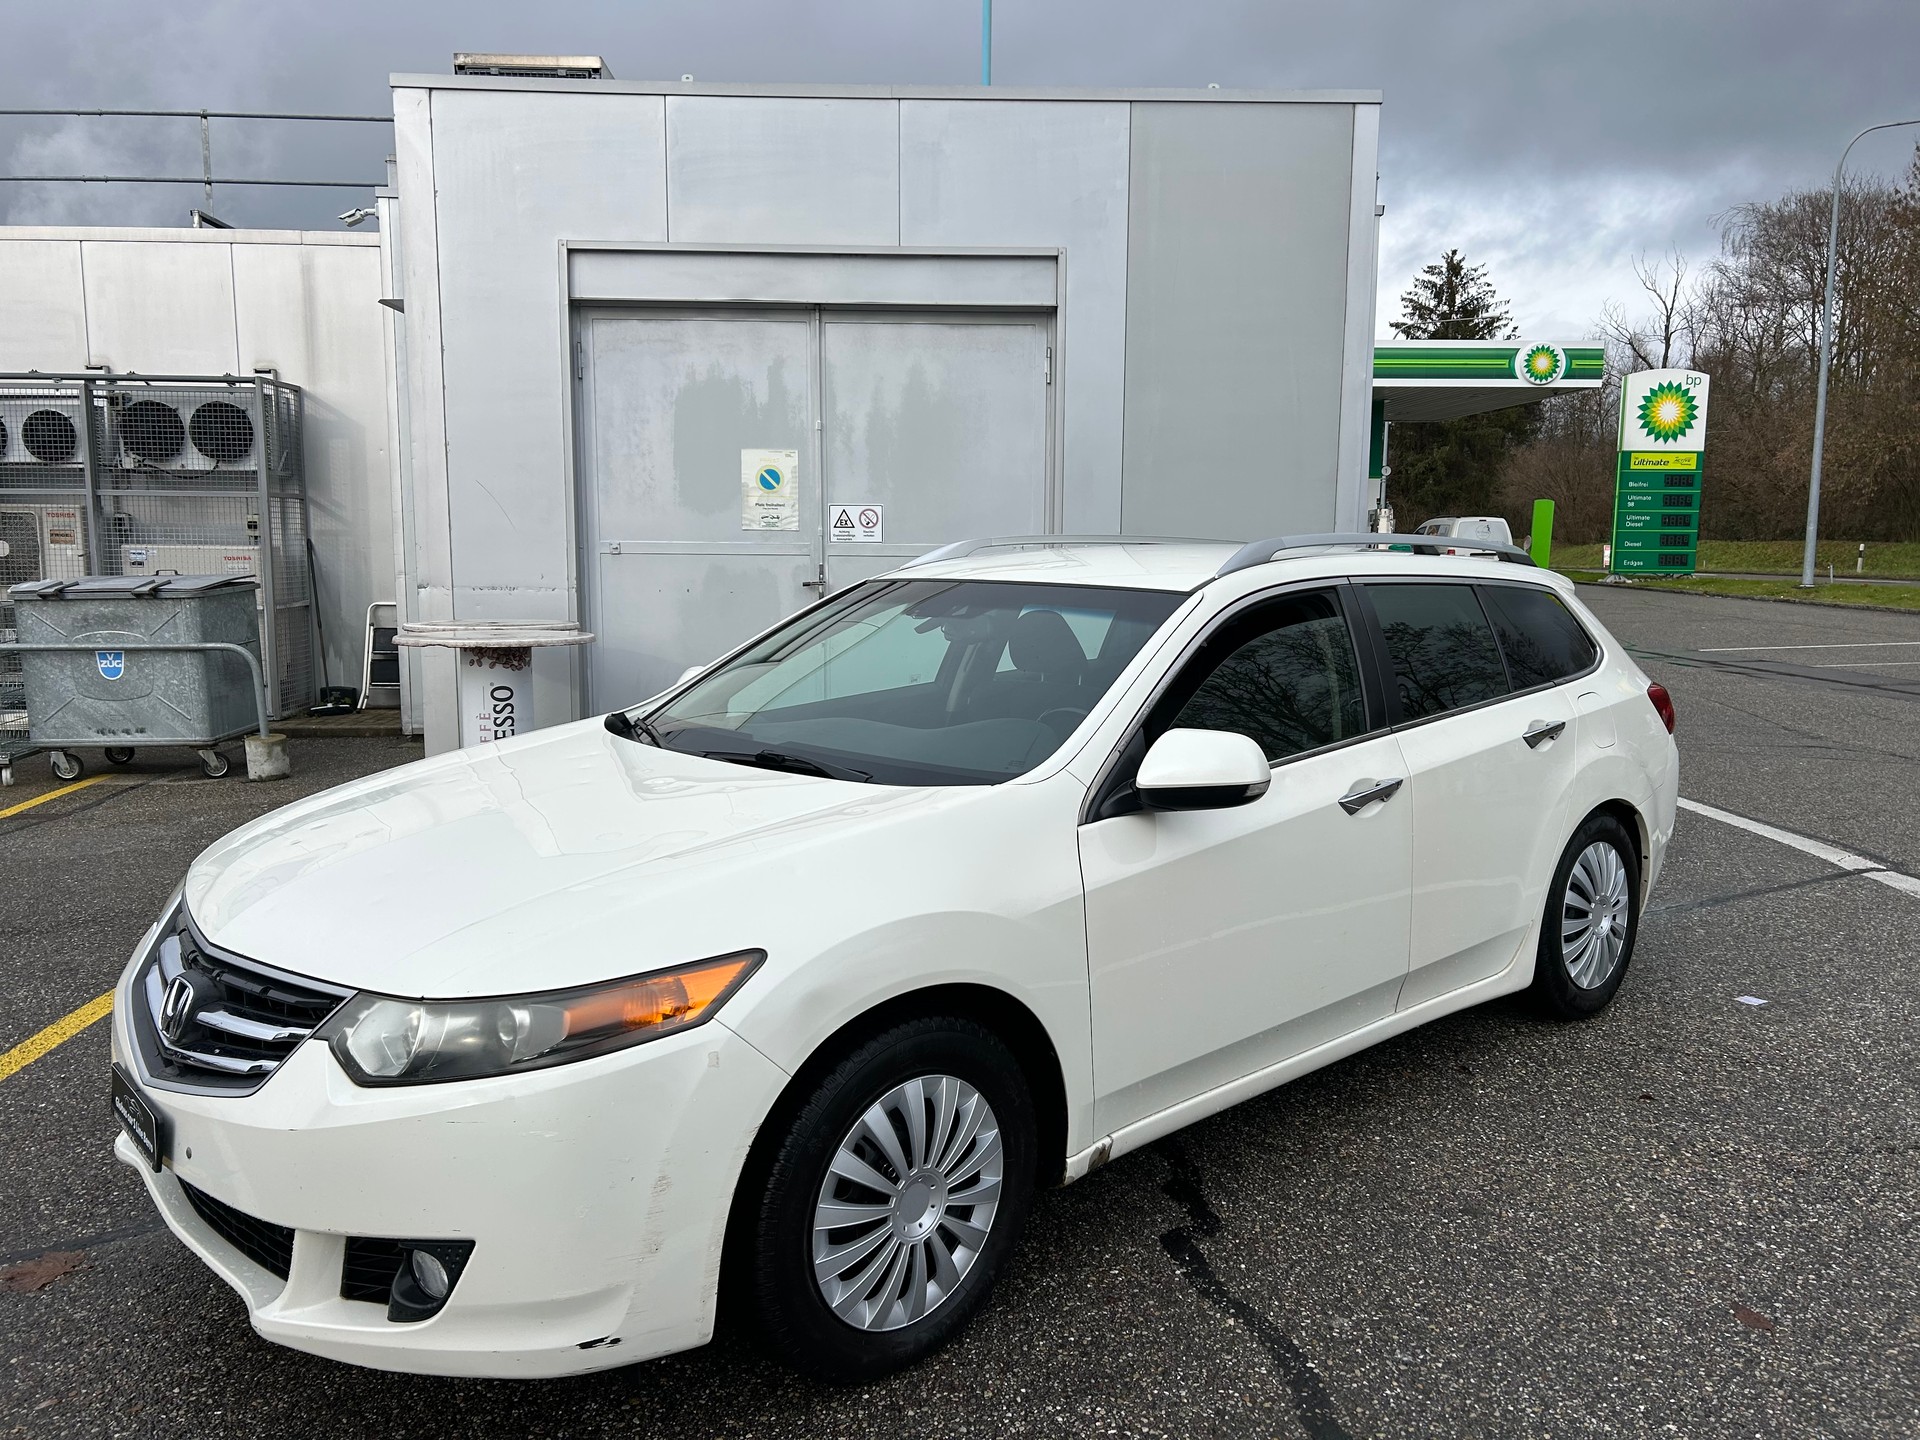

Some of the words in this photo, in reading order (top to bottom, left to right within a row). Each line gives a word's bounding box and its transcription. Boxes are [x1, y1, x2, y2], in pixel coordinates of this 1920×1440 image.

[1685, 374, 1702, 388] bp
[1633, 458, 1670, 466] ultimate
[1623, 559, 1643, 567] Erdgas
[100, 660, 122, 668] ZUG
